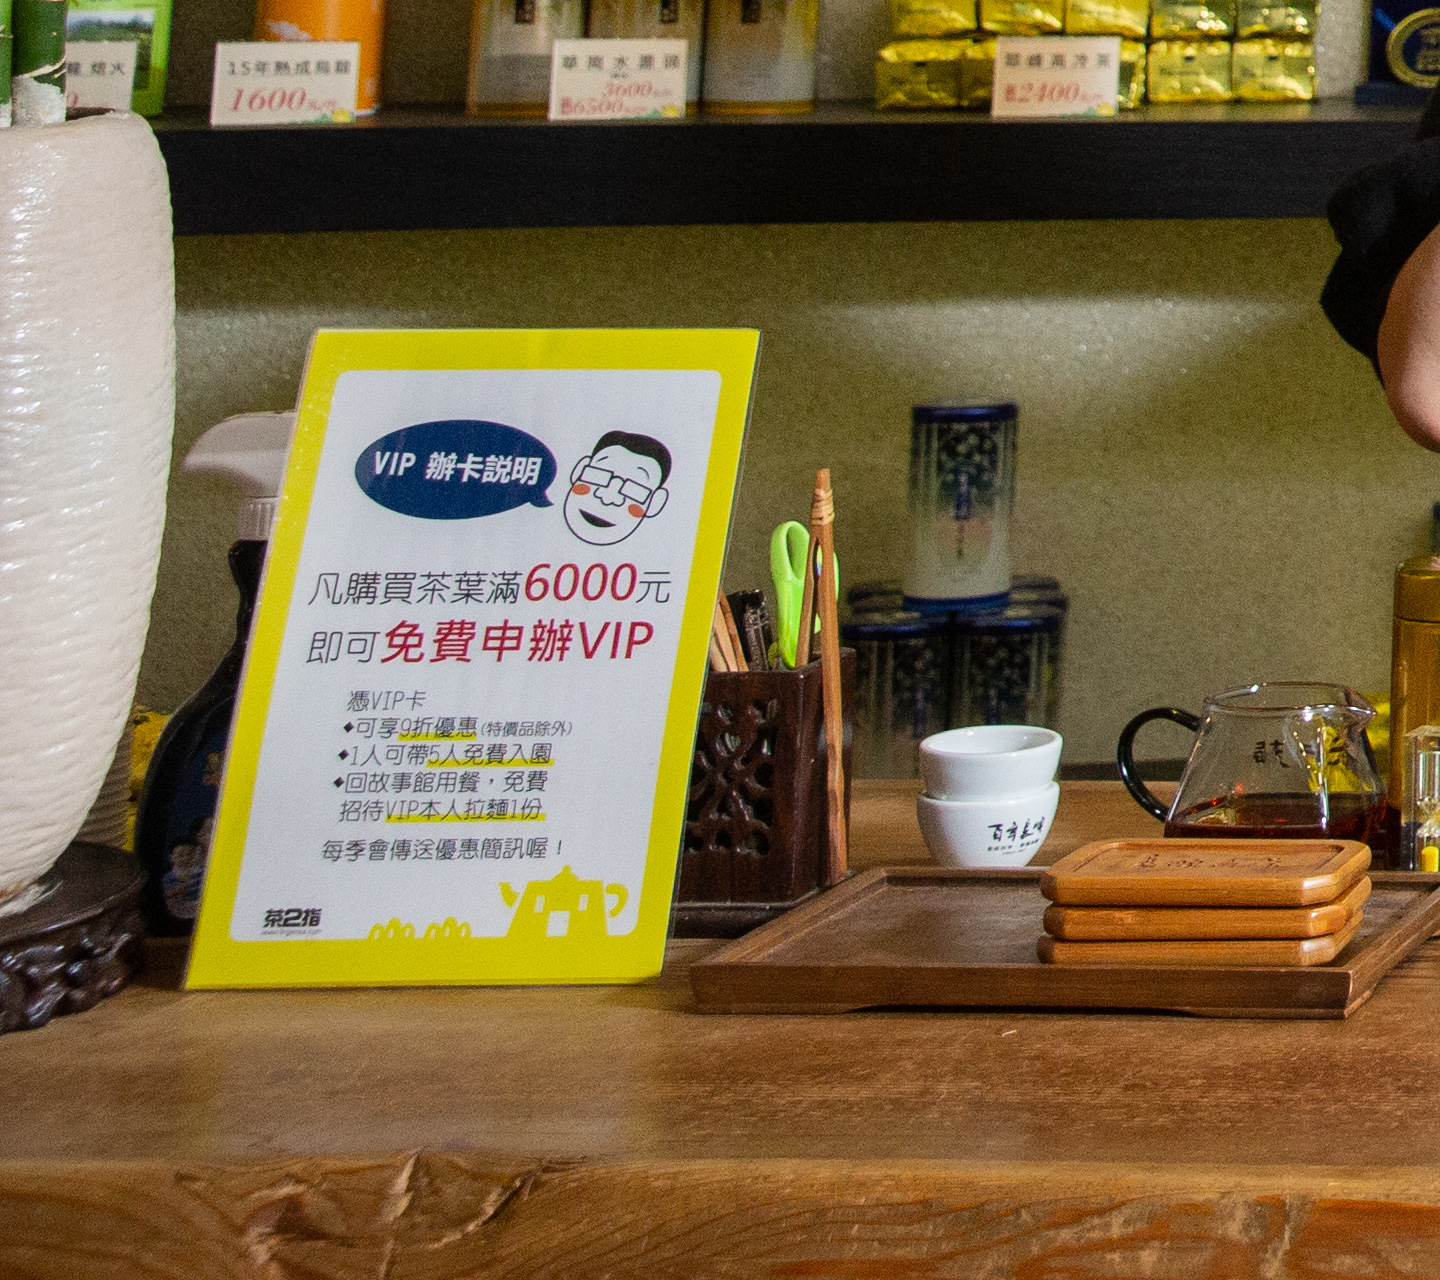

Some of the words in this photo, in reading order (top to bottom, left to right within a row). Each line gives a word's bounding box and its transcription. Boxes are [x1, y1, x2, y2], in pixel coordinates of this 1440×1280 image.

[373, 451, 416, 476] VIP
[306, 562, 672, 607] 凡購買茶葉滿6000元
[305, 619, 655, 665] 即可免費申辦VIP
[346, 688, 427, 713] 憑VIP卡
[350, 743, 553, 767] 1人可帶5人免費入園
